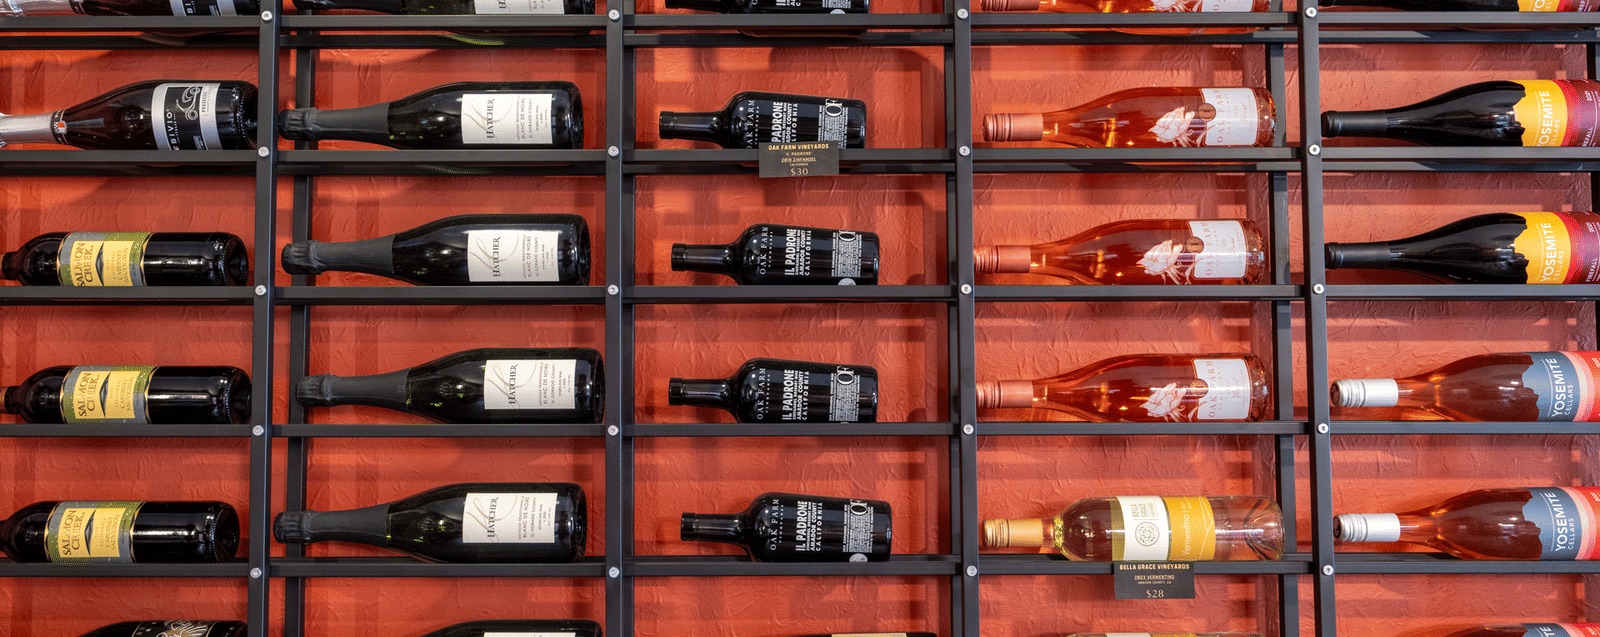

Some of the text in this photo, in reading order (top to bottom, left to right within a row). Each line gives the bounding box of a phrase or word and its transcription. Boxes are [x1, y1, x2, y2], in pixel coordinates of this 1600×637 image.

[166, 112, 177, 144] BIVIO
[487, 98, 495, 138] HATCHER
[771, 102, 783, 142] PADRONE
[825, 99, 842, 117] OF
[1539, 91, 1553, 146] OSEMITE
[1550, 119, 1560, 146] ELLARS
[73, 243, 85, 286] SALMON
[493, 237, 501, 277] HATCHER
[759, 227, 768, 275] OAK FARM
[785, 229, 796, 275] IL PADRONE
[1540, 223, 1556, 282] YOSEMITE
[1553, 250, 1564, 280] CELLARS
[78, 373, 91, 416] SALMON
[126, 377, 134, 411] SAUVIGNON
[508, 364, 518, 404] HATCHER
[782, 370, 794, 411] PADRONE
[837, 366, 854, 384] OF
[1545, 358, 1566, 417] YOSEMITE
[1208, 396, 1217, 417] OAK
[1564, 385, 1574, 415] CELLARS
[487, 497, 499, 537] HATCHER
[769, 499, 779, 550] OAK FARM
[796, 501, 808, 551] IL PADRONE
[1140, 503, 1148, 517] GRACE
[1544, 492, 1568, 551] YOSEMITE
[62, 510, 76, 556] SALMON
[104, 517, 113, 548] CABERNET
[111, 514, 120, 551] SAUVIGNON
[1181, 513, 1191, 556] Vermentino
[1146, 589, 1164, 598] $28
